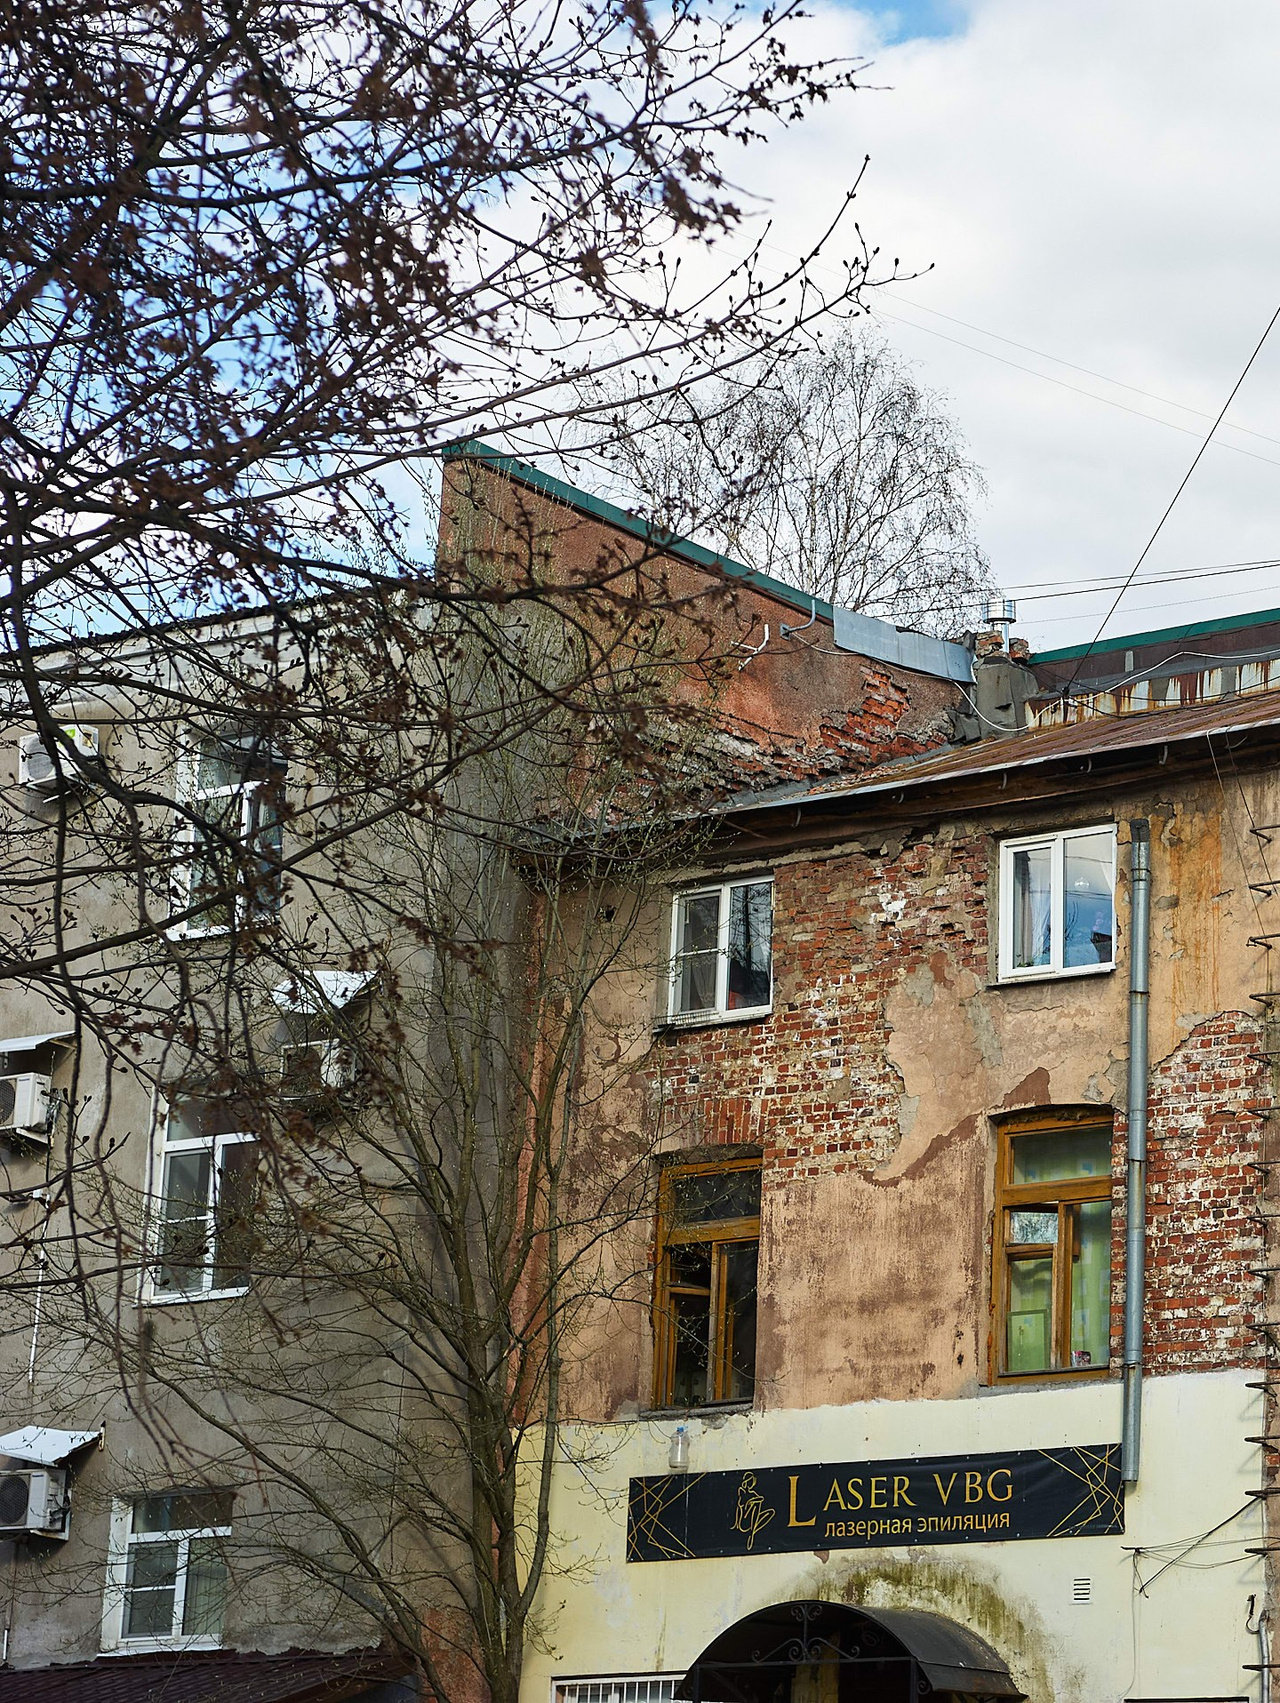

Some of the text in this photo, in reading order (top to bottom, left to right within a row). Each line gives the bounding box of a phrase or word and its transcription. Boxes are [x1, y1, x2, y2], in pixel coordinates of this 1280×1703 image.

[787, 1468, 1014, 1527] LASER VBG
[824, 1512, 1010, 1540] лазерная эпиляция
